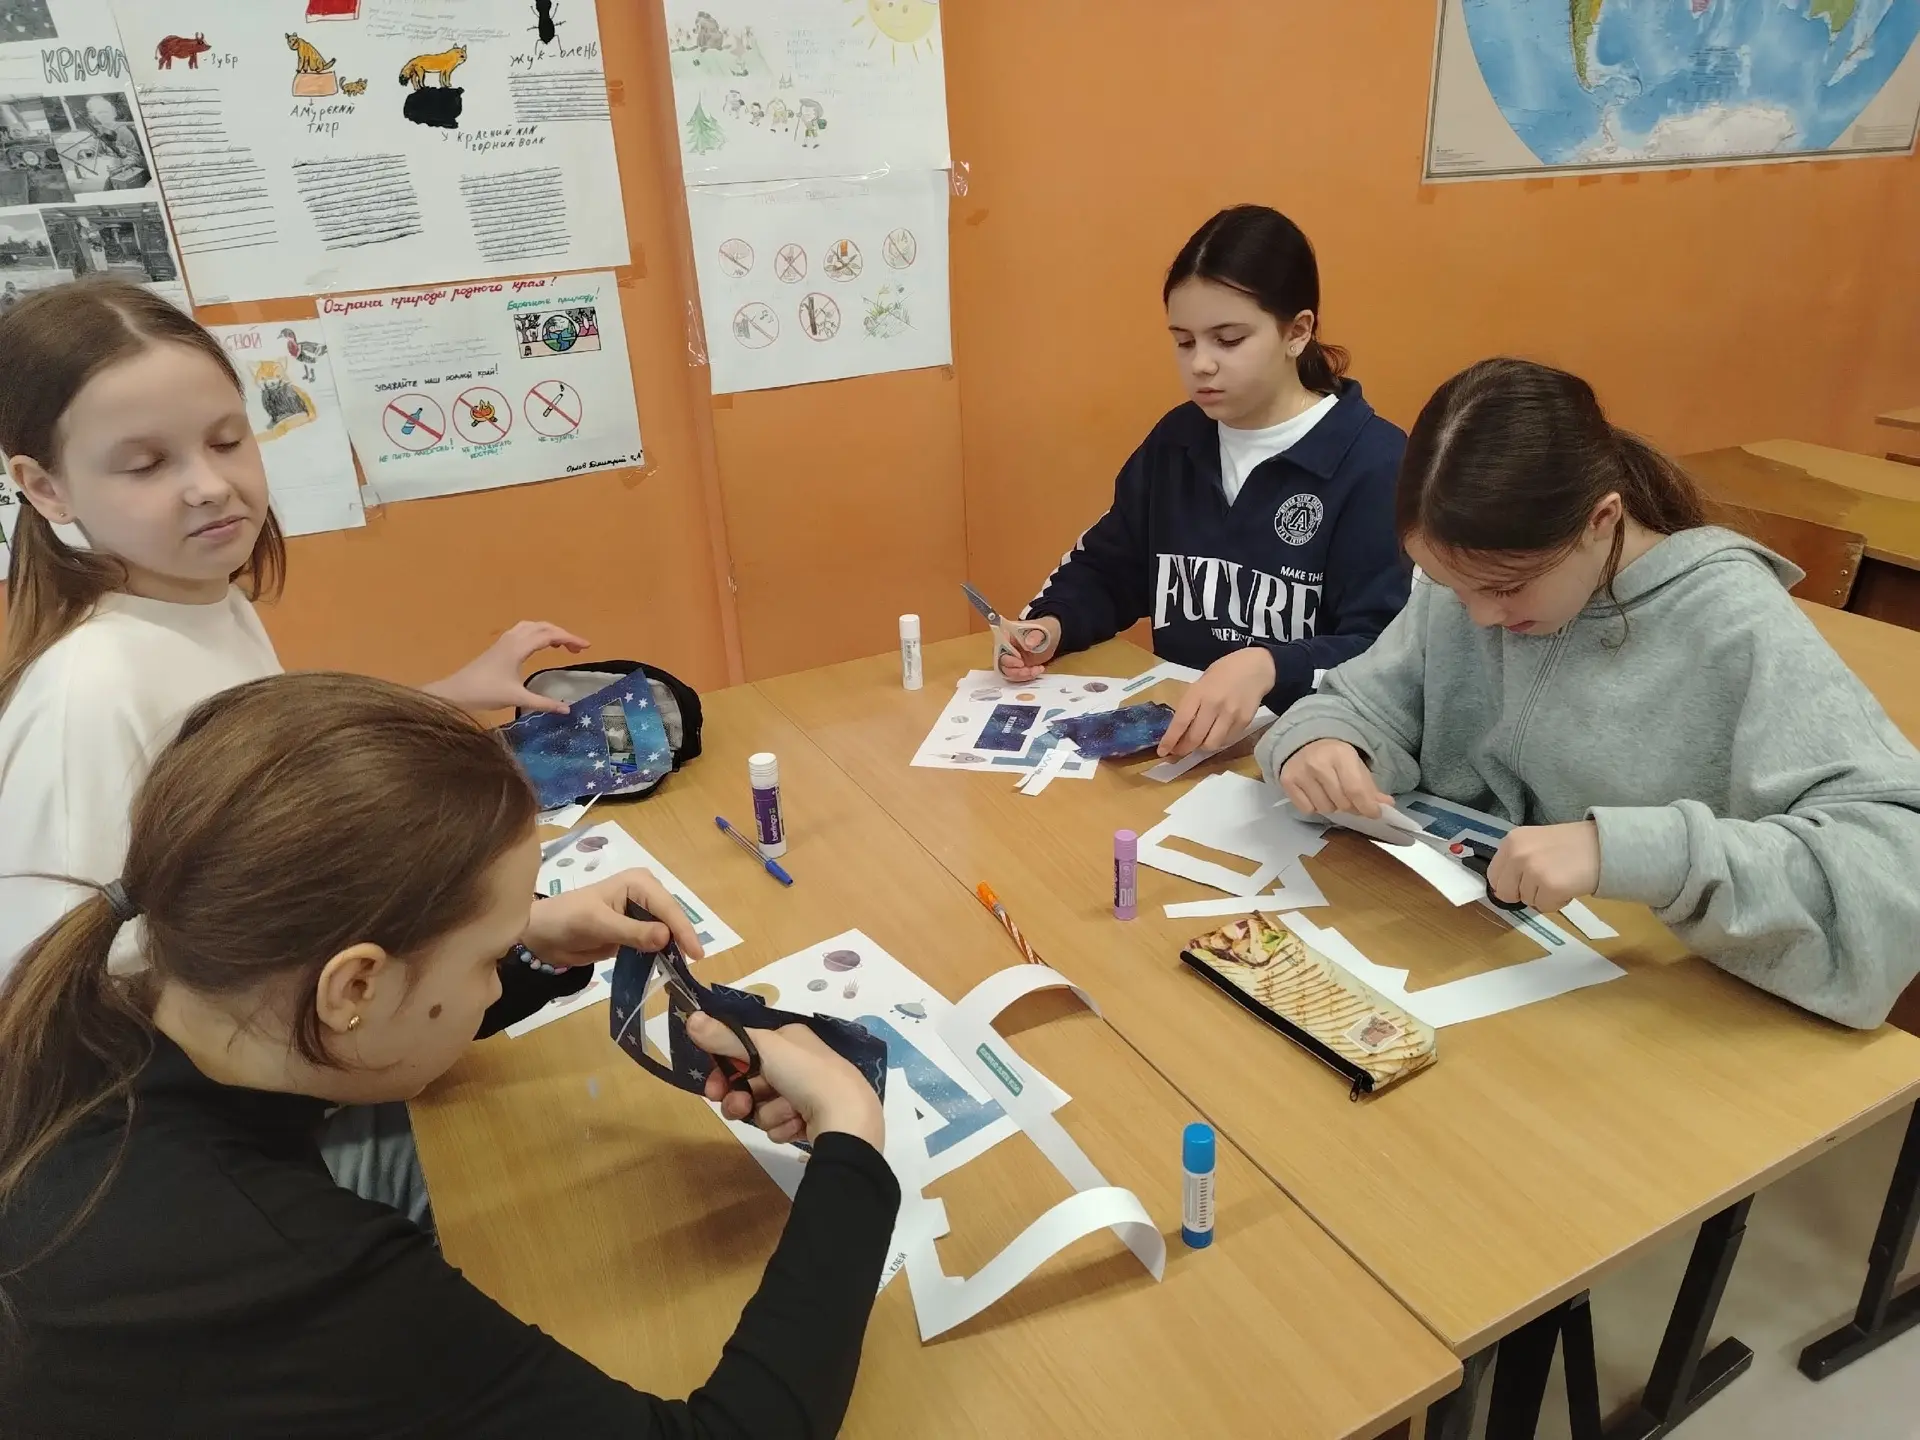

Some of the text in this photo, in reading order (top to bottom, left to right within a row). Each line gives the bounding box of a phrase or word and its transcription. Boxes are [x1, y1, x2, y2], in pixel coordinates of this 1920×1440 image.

[323, 298, 384, 316] Охрана
[391, 290, 447, 309] природы
[450, 284, 503, 301] родного
[1280, 565, 1324, 583] MAKE THE
[1153, 553, 1323, 643] FUTURE
